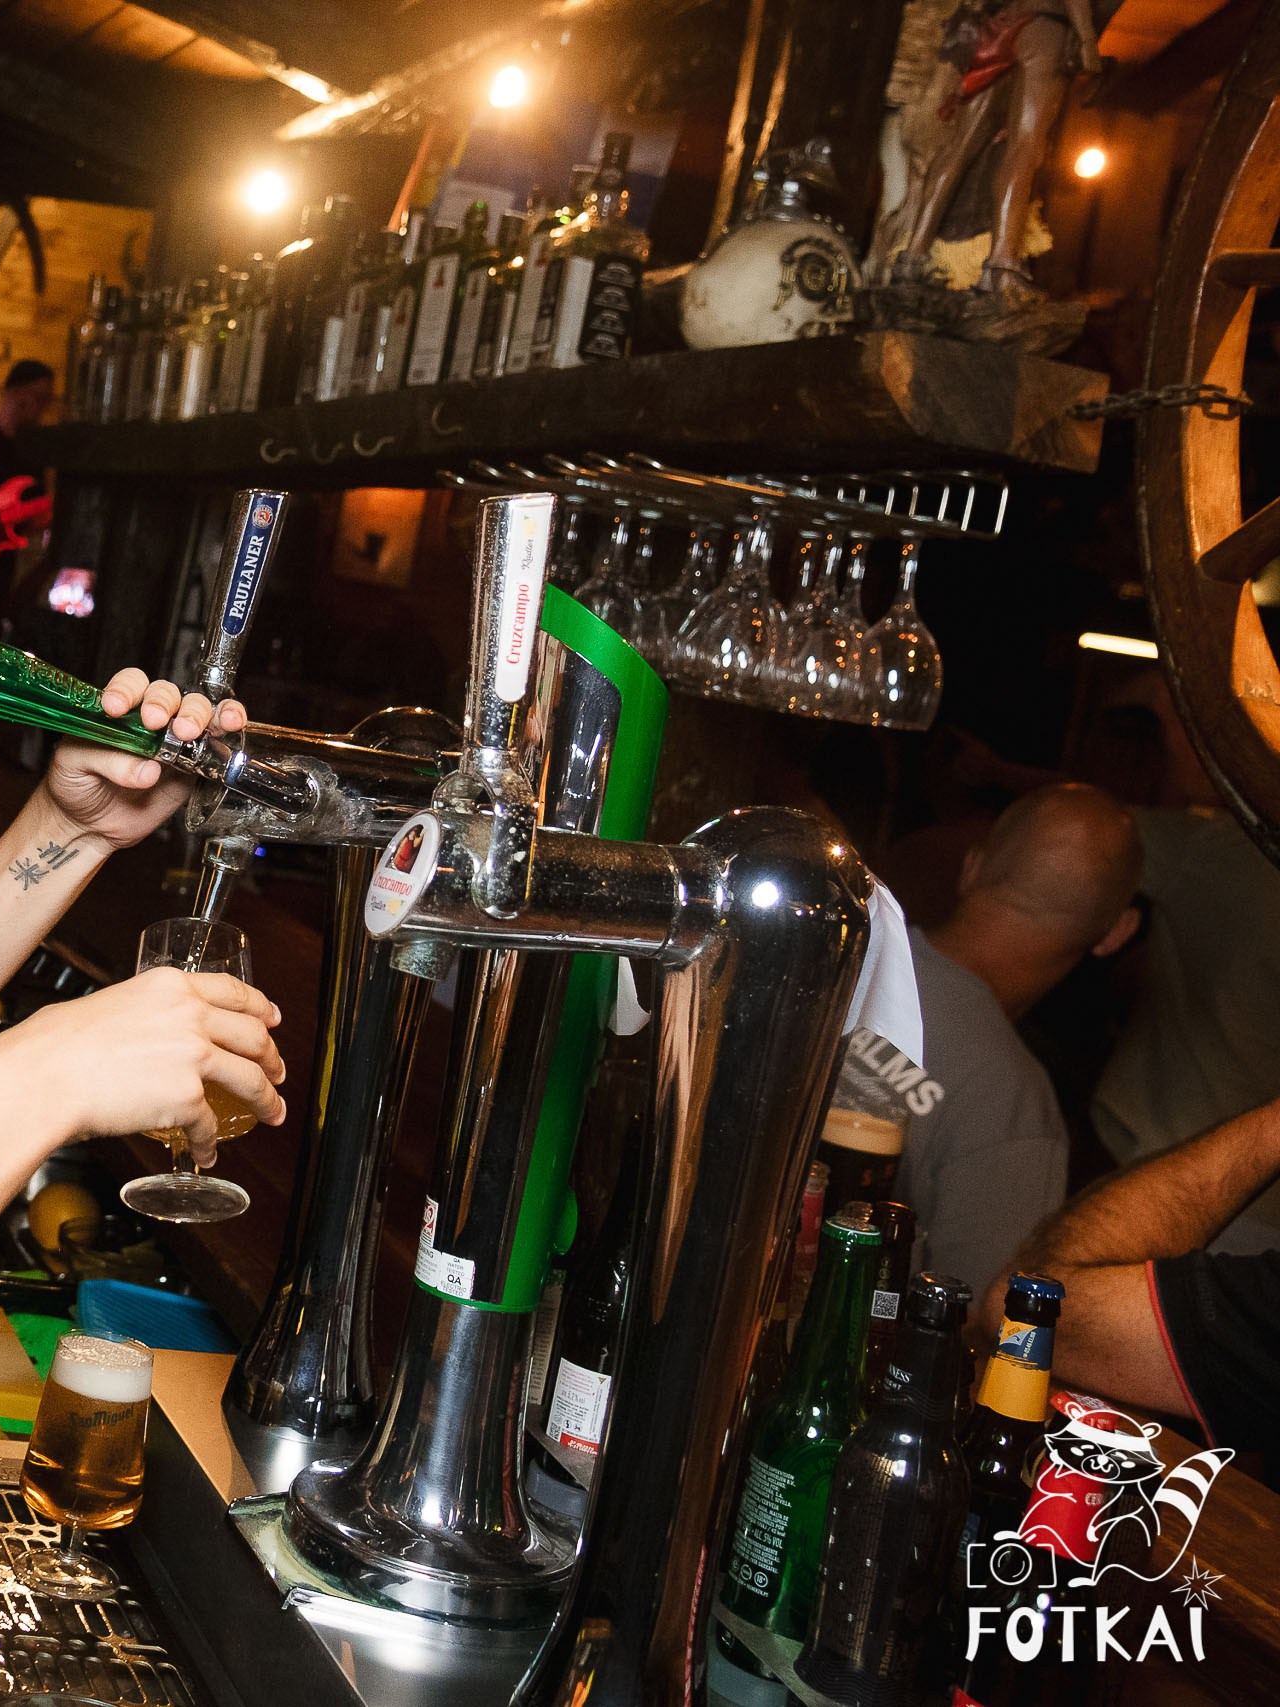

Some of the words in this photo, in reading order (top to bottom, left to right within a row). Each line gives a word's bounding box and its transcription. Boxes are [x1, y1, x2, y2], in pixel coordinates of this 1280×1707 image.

[521, 538, 534, 570] Radler
[228, 535, 264, 620] PAULANER
[505, 583, 530, 665] Cruzcampo
[372, 873, 413, 896] Cruzcampo
[447, 1274, 462, 1286] QA
